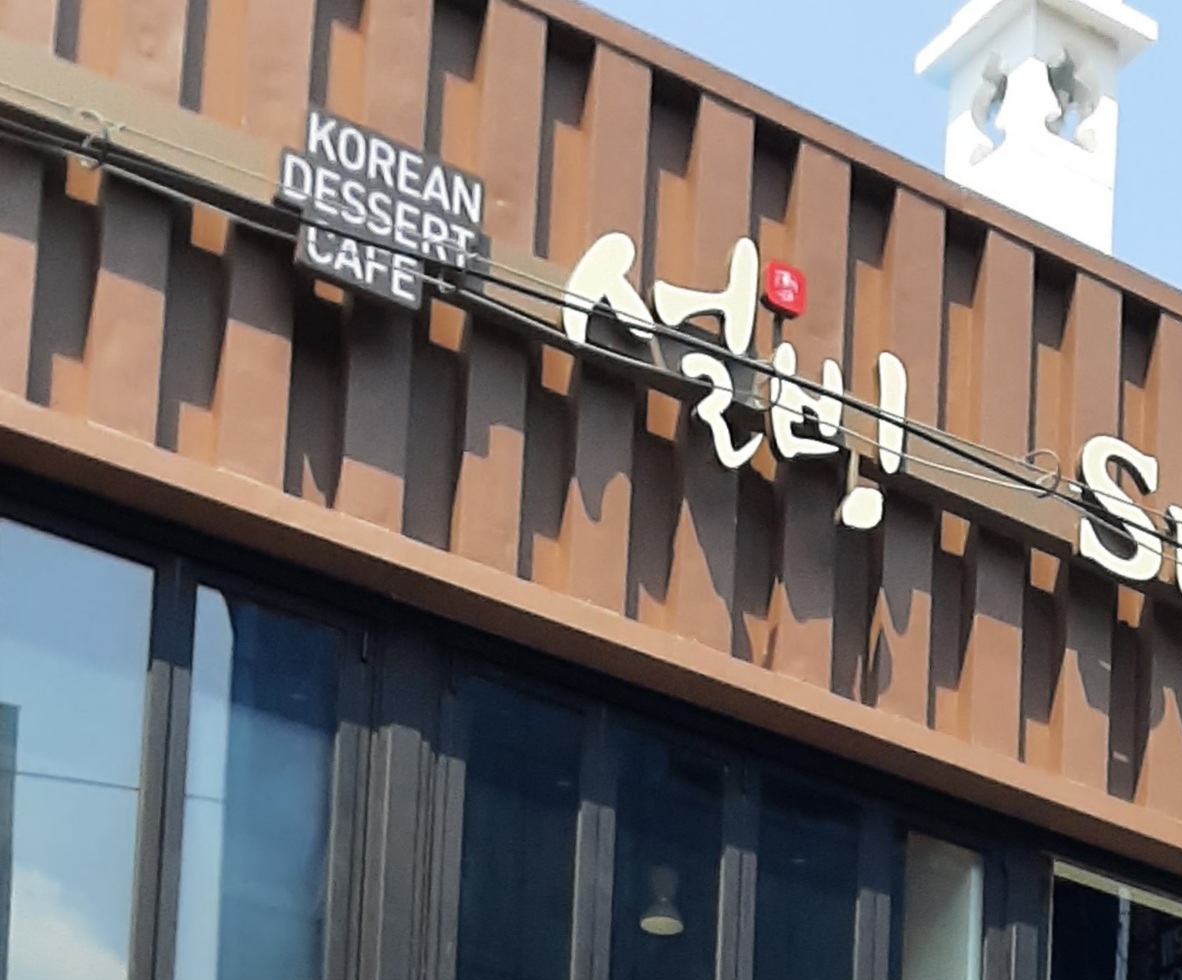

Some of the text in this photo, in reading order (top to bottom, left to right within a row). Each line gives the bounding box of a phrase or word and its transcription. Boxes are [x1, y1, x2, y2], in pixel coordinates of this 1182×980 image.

[282, 153, 475, 269] DESSERT
[308, 111, 482, 224] KOREAN
[306, 226, 417, 302] CAFE
[562, 232, 906, 529] 설빙
